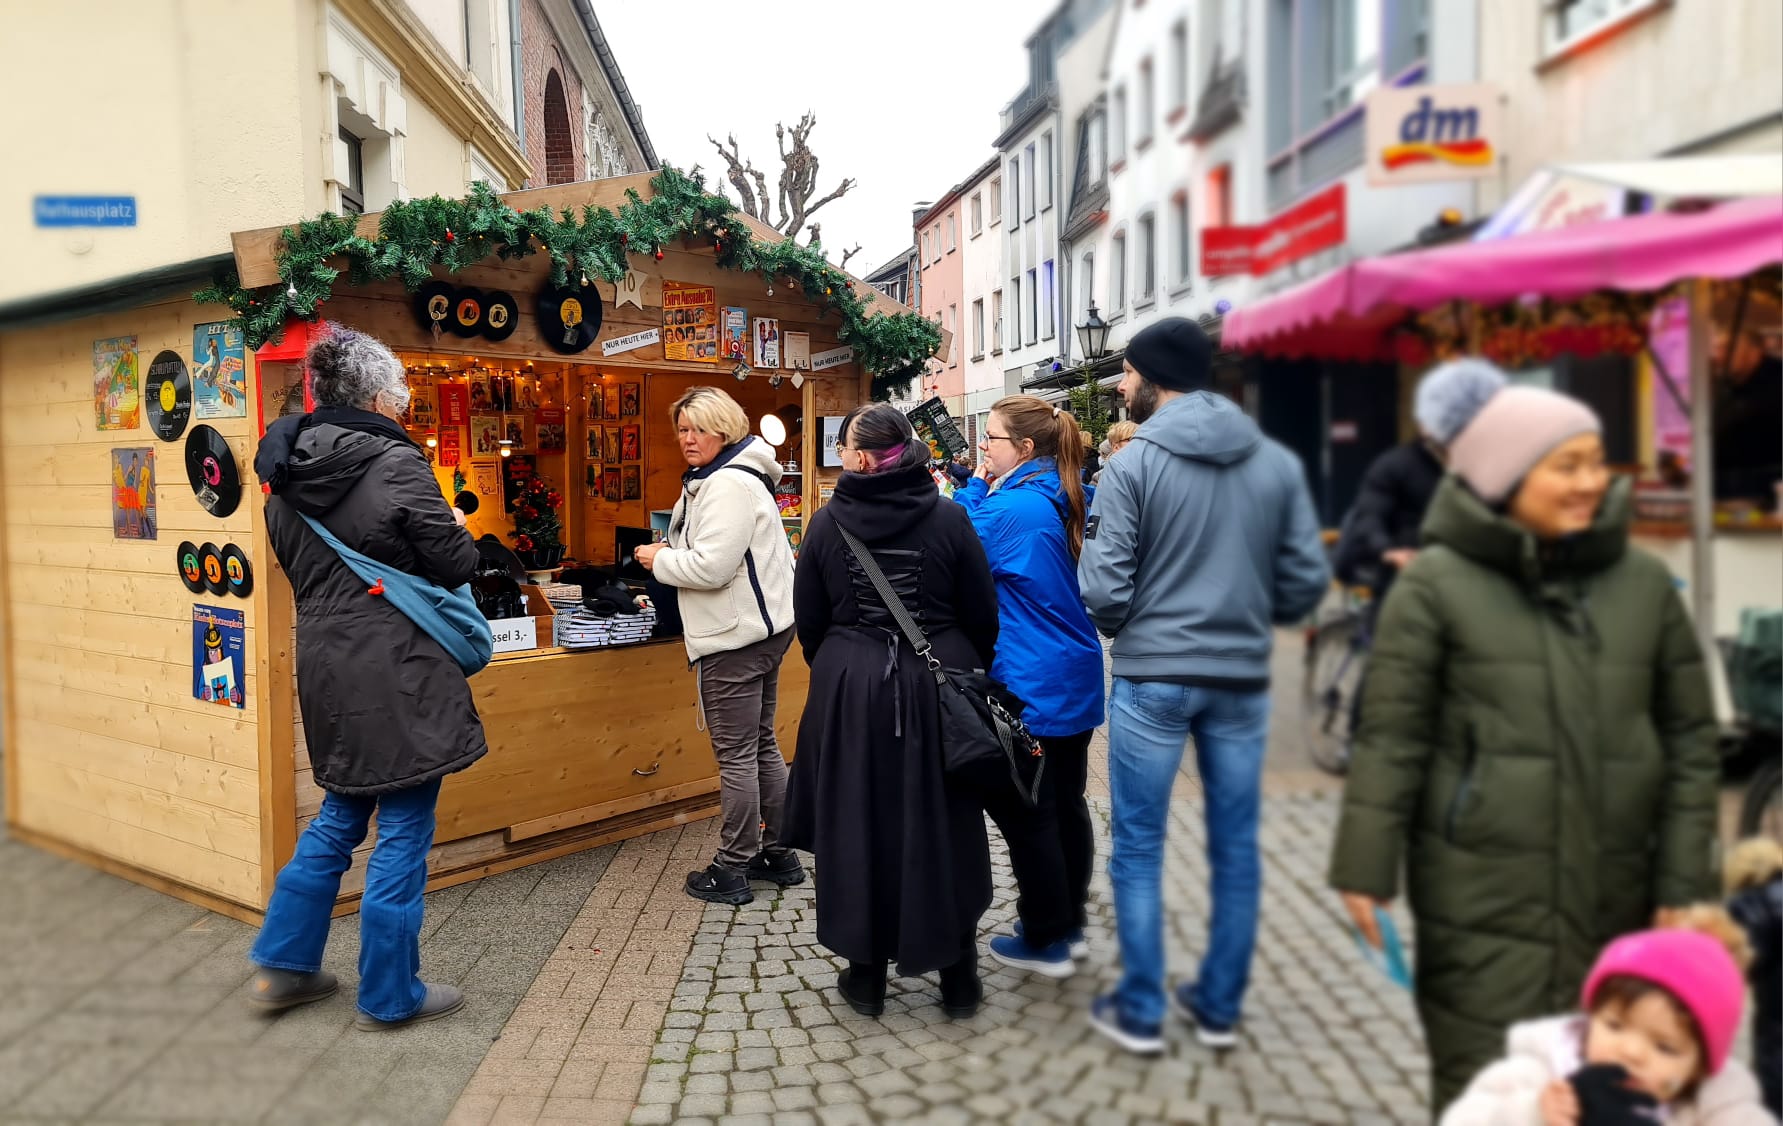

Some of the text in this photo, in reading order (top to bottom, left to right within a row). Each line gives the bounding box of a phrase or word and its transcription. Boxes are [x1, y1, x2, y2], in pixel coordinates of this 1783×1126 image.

[1399, 96, 1479, 142] dm
[664, 291, 680, 306] Extra
[605, 331, 653, 349] NUR HEUTE HIER
[814, 353, 849, 367] NUR HEUTE HIER
[492, 629, 528, 643] ssel 3,-
